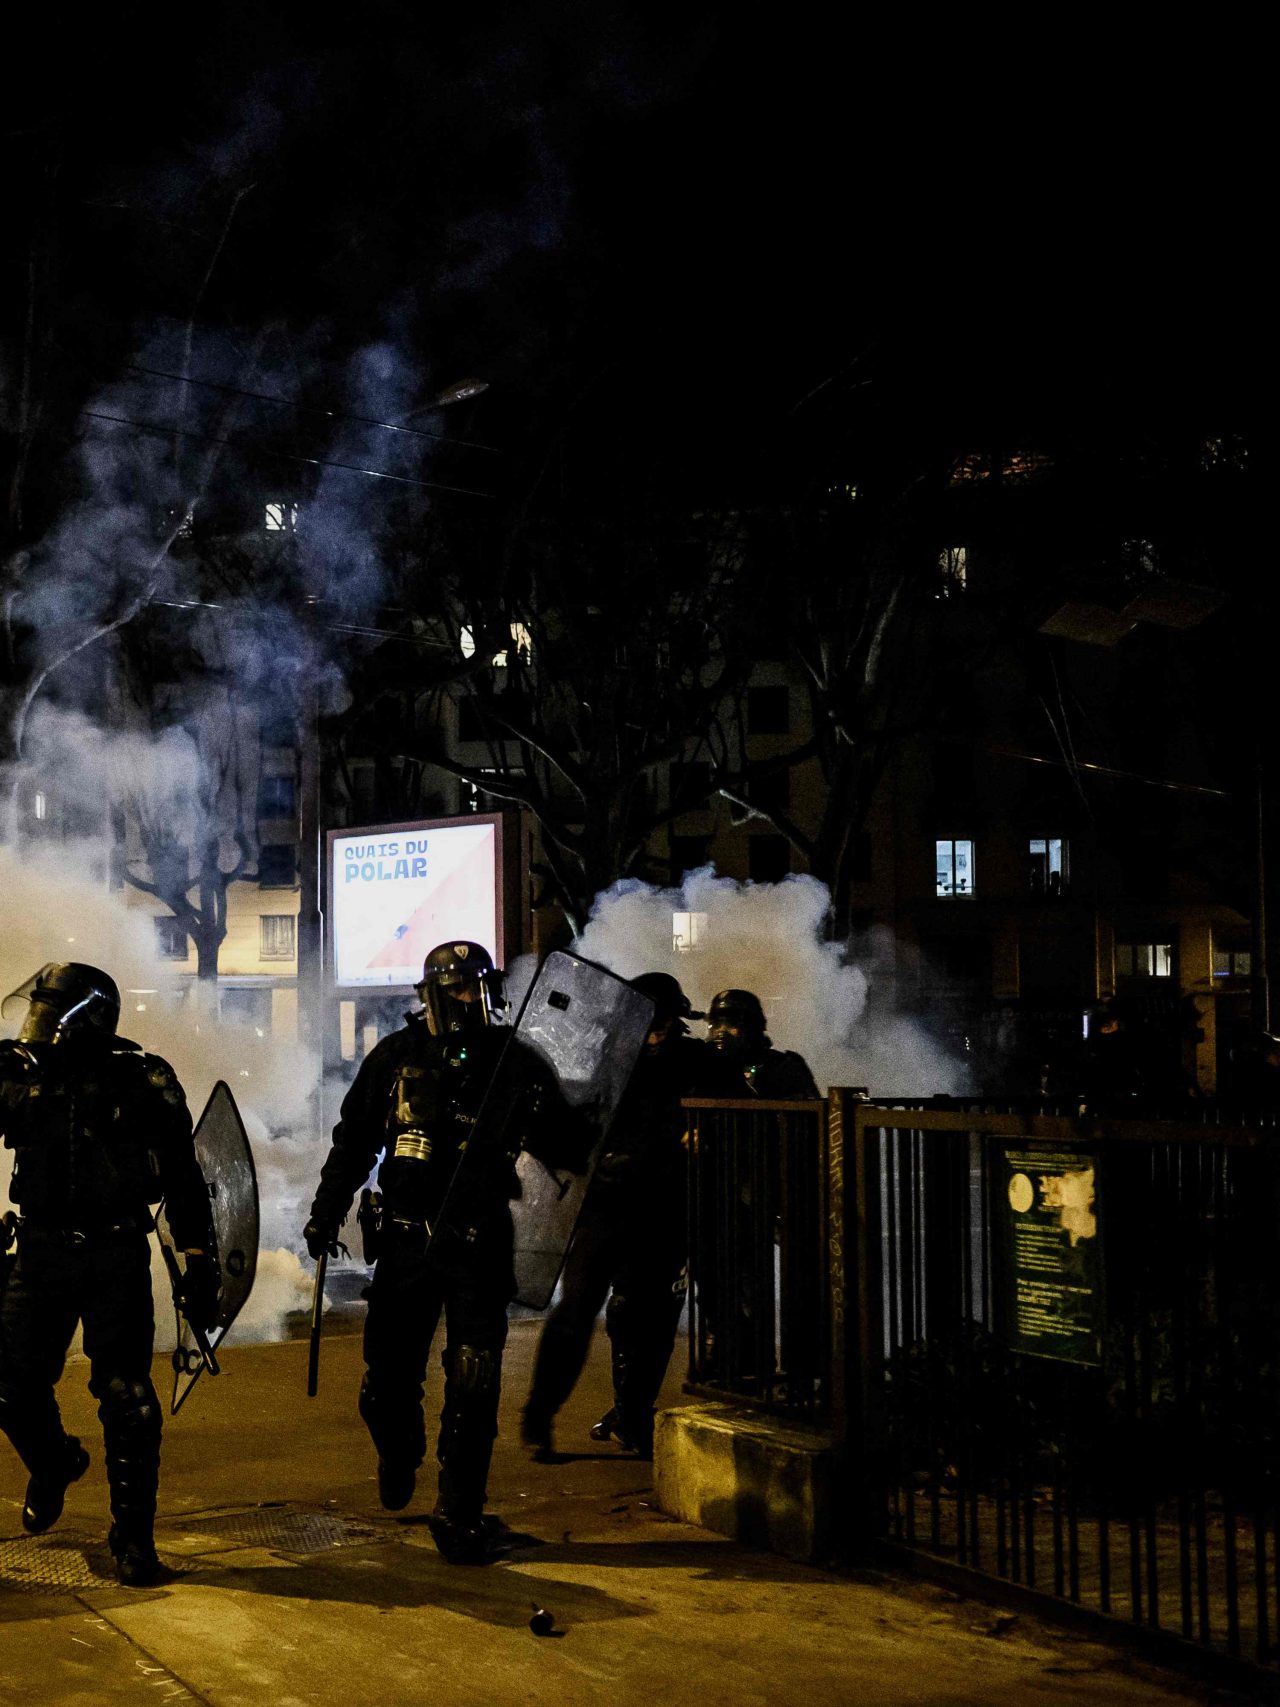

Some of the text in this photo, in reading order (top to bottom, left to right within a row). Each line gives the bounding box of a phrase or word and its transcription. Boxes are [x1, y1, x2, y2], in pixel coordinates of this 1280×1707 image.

[345, 840, 428, 860] QUAIS DU
[345, 857, 427, 883] POLAR
